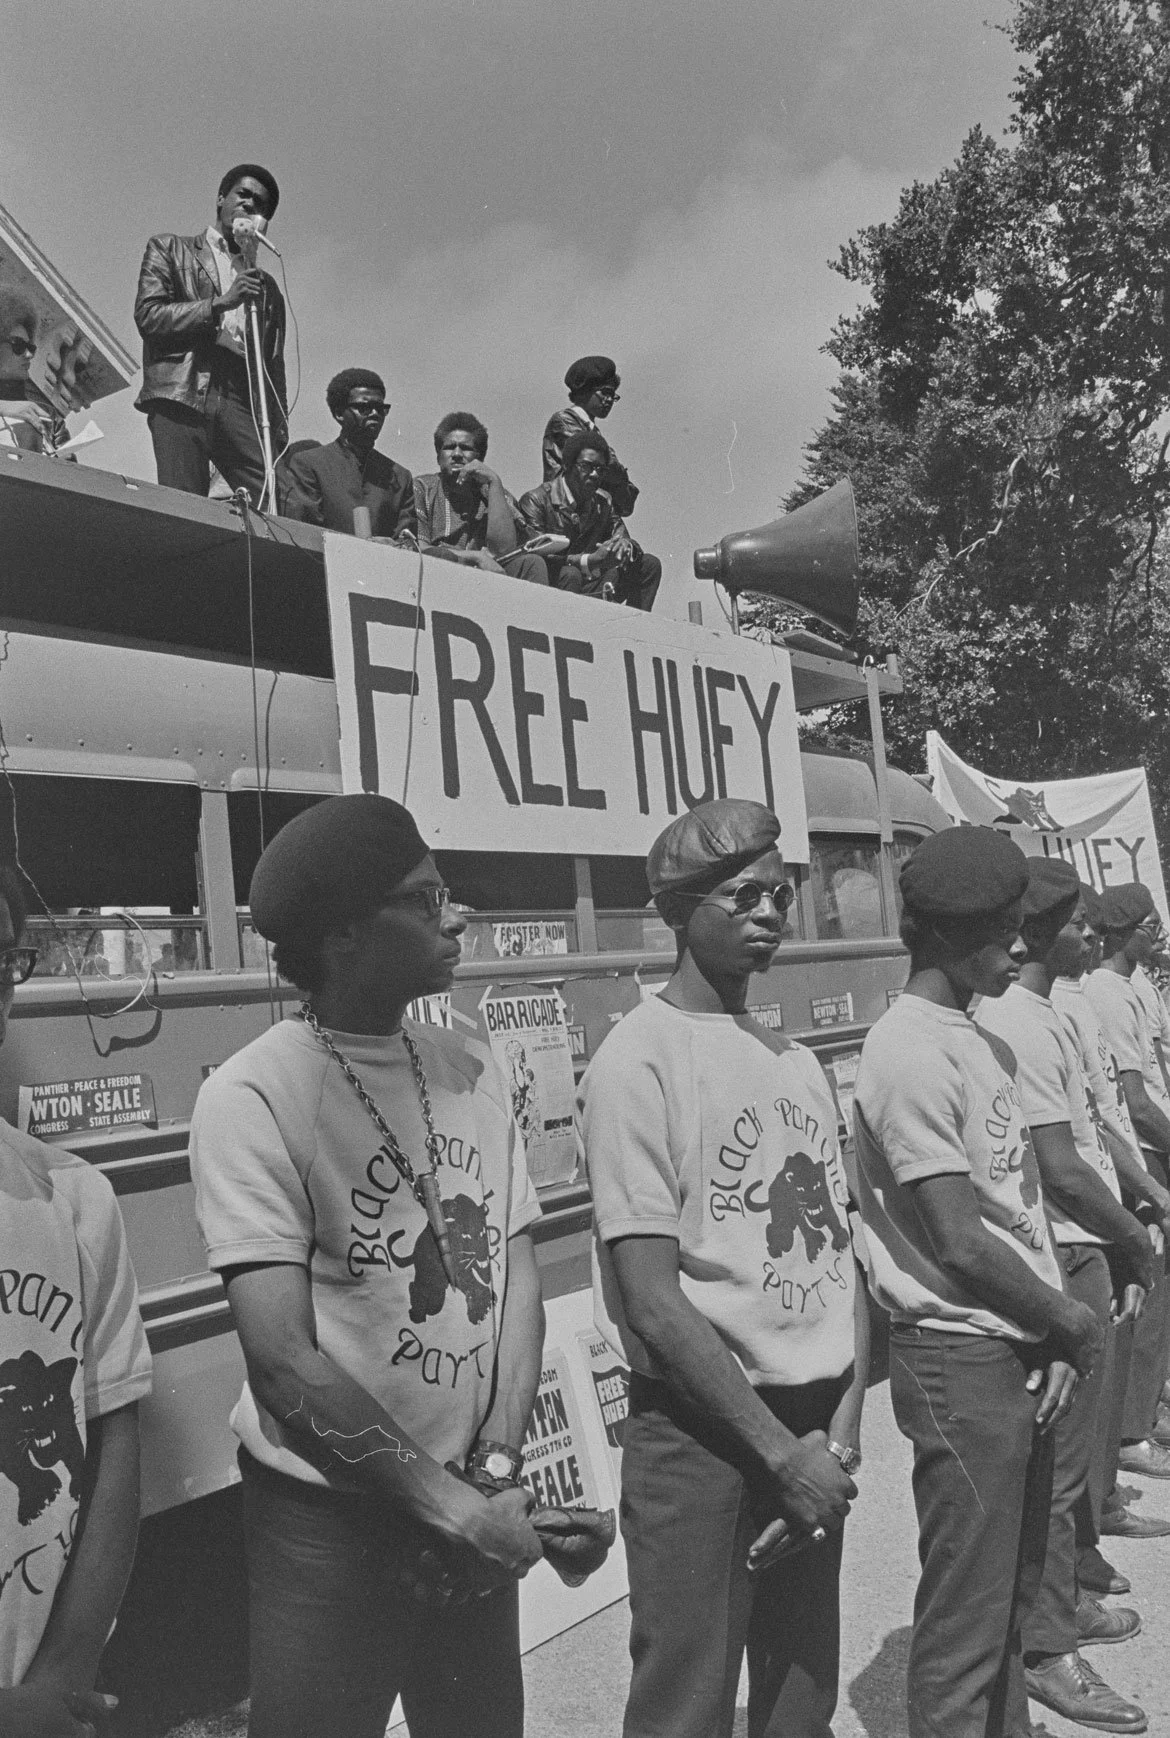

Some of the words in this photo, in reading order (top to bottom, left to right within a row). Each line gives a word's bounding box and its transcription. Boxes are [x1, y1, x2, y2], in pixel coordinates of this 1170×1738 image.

[348, 592, 607, 810] FREE
[623, 649, 781, 815] HUEY
[545, 925, 565, 941] NOW
[486, 998, 562, 1032] BARRICADE
[34, 1083, 69, 1097] PANTHER
[74, 1080, 99, 1092] PEACE
[100, 1079, 106, 1088] &
[107, 1075, 142, 1088] FREEDOM
[94, 1088, 141, 1113] SEALE
[30, 1120, 69, 1135] CONGRESS
[89, 1117, 111, 1127] STATE
[113, 1109, 151, 1124] ASSEMBLY
[596, 1374, 626, 1404] FREE
[602, 1397, 629, 1426] HUEY
